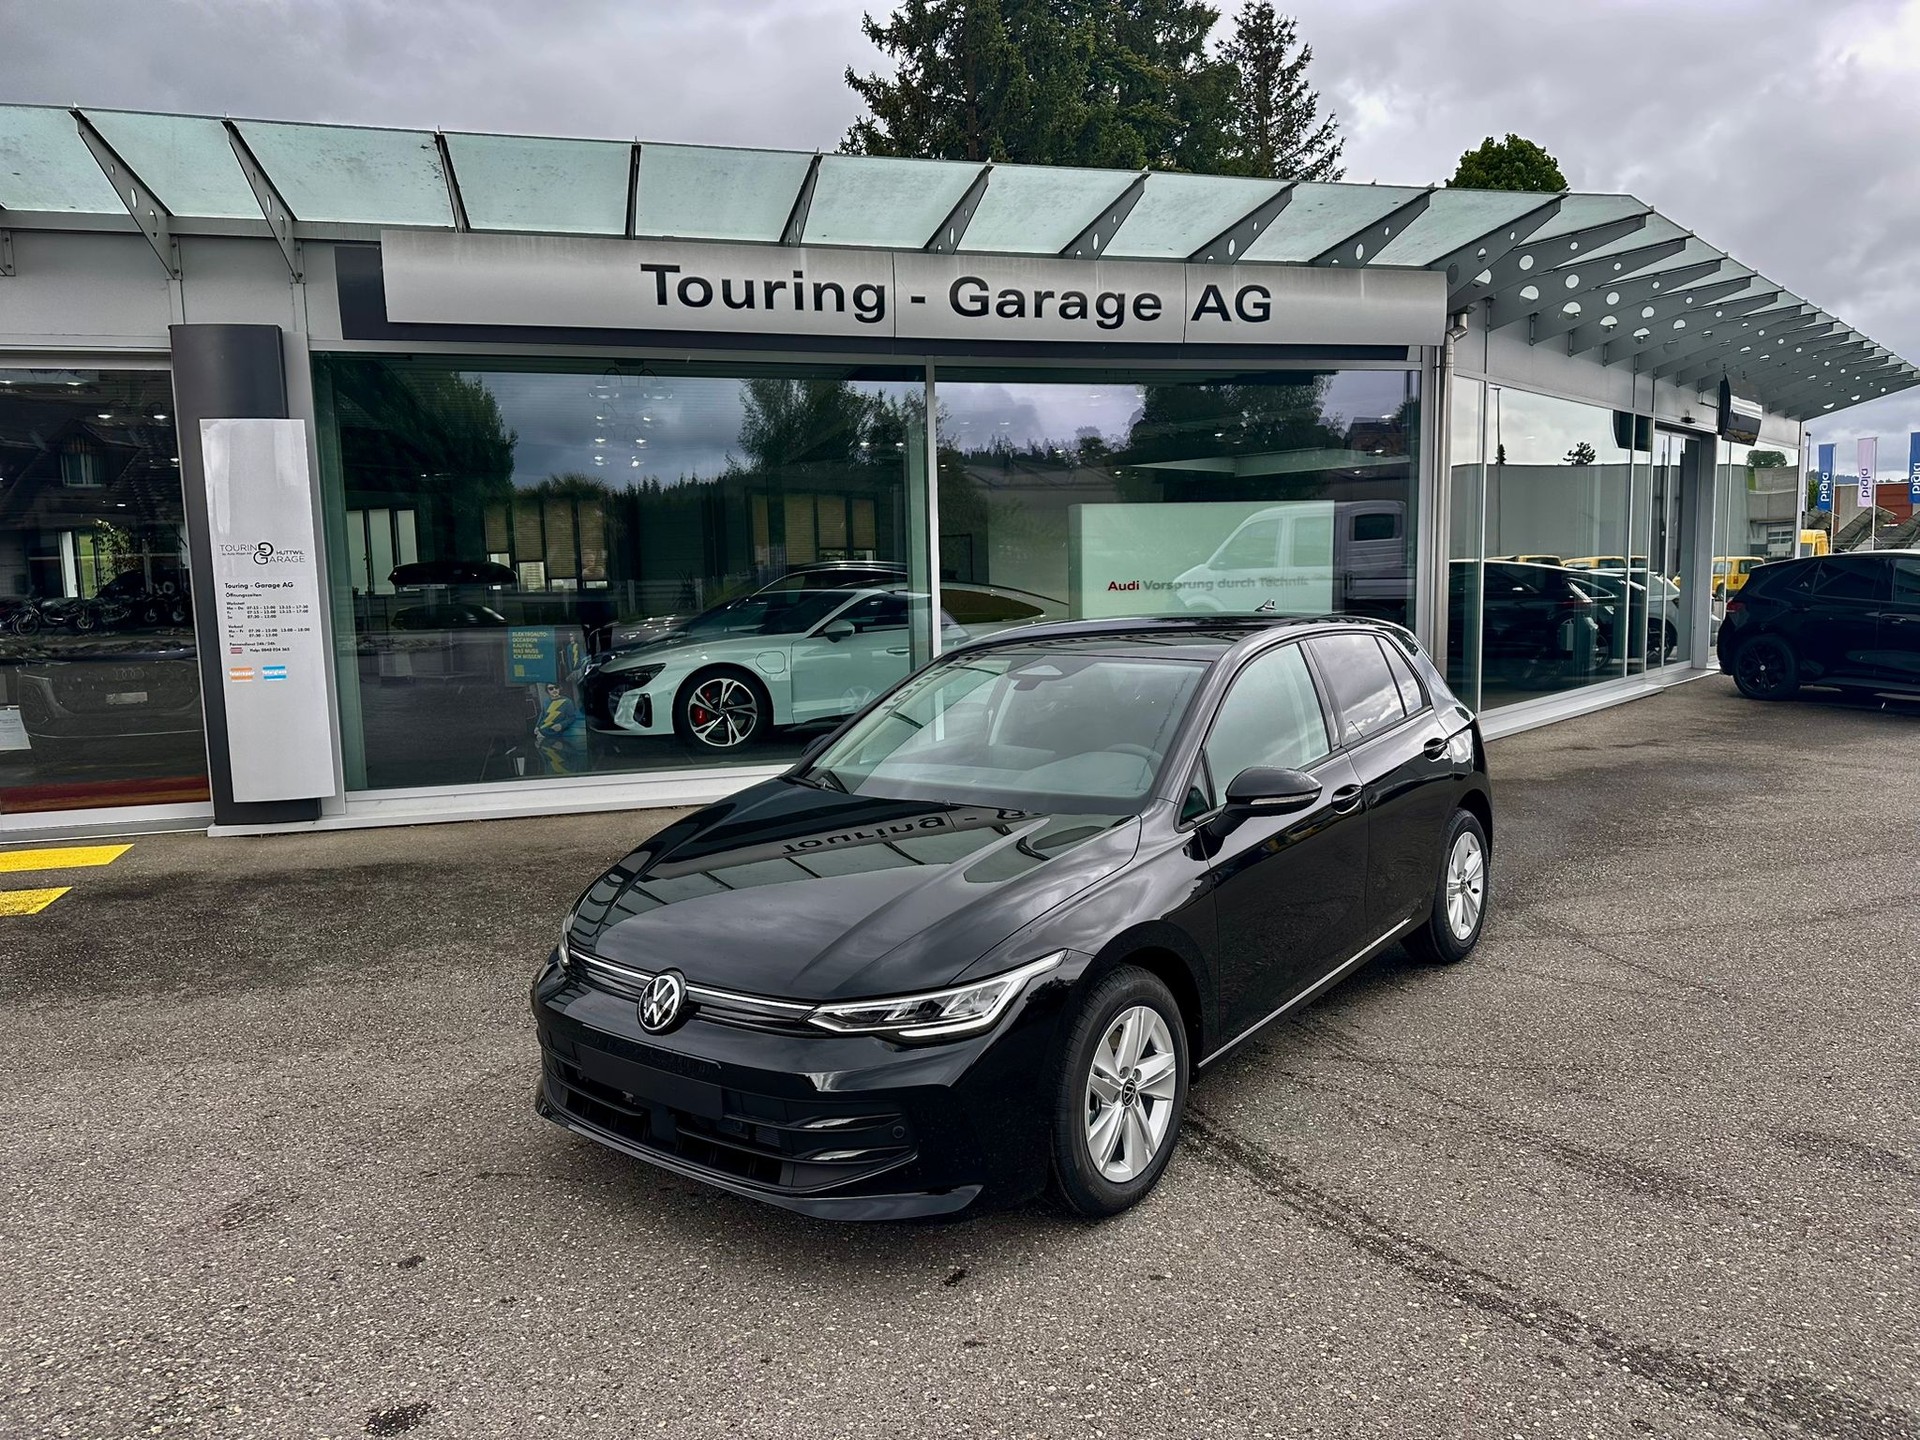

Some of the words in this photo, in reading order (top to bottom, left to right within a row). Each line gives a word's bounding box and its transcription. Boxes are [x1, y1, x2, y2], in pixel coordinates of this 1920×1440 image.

[640, 263, 886, 323] Touring
[911, 295, 926, 305] -
[949, 276, 1162, 329] Garage
[1191, 285, 1271, 323] AG
[1107, 580, 1139, 591] Audi
[1143, 579, 1213, 592] Vorsprung
[1218, 577, 1255, 589] durch
[1259, 576, 1309, 588] Technik
